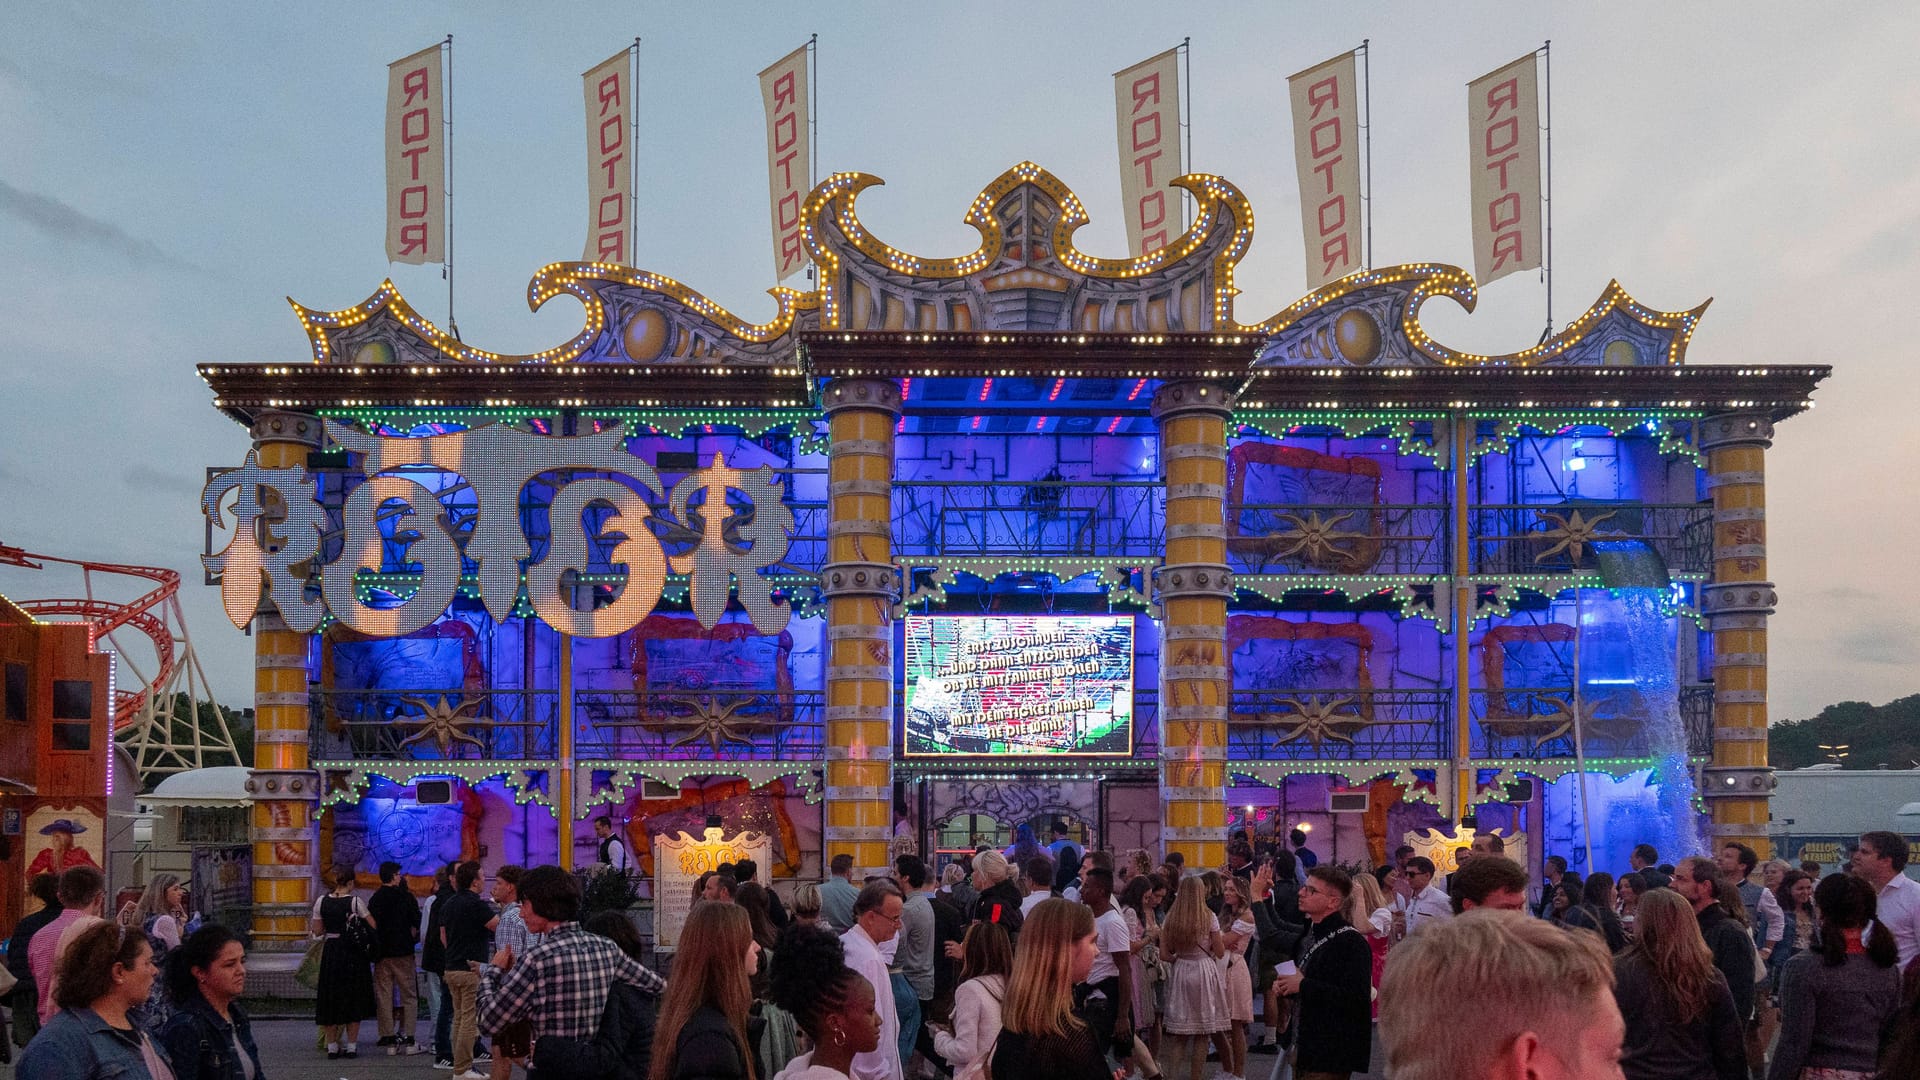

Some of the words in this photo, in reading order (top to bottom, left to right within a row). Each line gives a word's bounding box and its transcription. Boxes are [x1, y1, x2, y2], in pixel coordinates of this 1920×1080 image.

[200, 420, 793, 637] ROTOR
[966, 641, 991, 655] ERST
[994, 632, 1065, 651] ZUSCHAUEN
[980, 657, 1014, 671] DANN
[1017, 644, 1099, 665] ENTSCHEIDEN
[943, 681, 960, 693] OB
[963, 678, 980, 690] SIE
[983, 668, 1051, 687] MITFAHREN
[1051, 661, 1100, 678] WOLLEN
[951, 712, 973, 727] MIT
[976, 709, 1005, 723] DEM
[1005, 703, 1053, 719] TICKET
[1055, 698, 1095, 713] HABEN
[987, 726, 1003, 739] SIE
[1006, 724, 1028, 737] DIE
[950, 783, 1069, 815] KASSE
